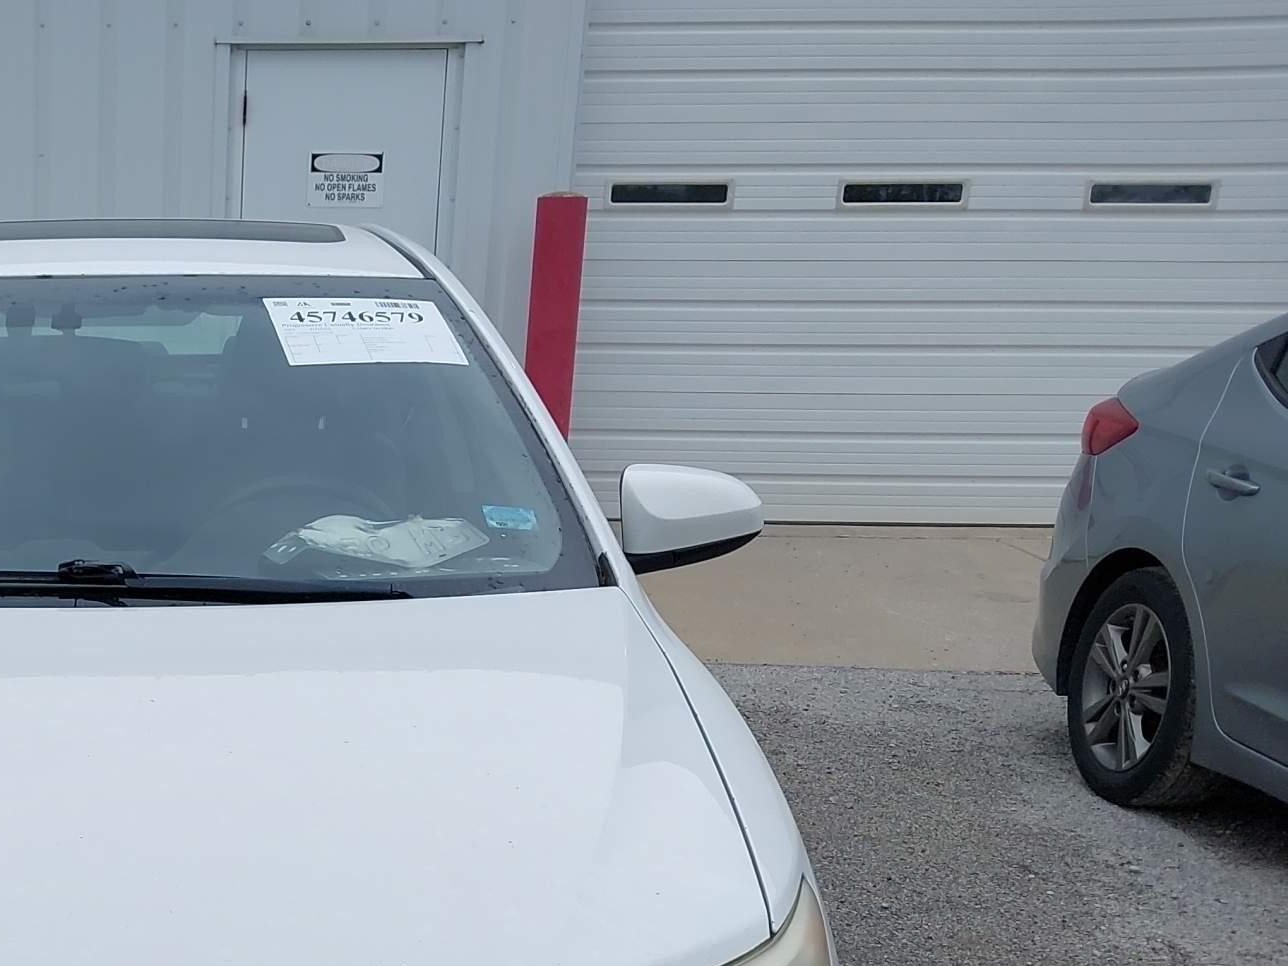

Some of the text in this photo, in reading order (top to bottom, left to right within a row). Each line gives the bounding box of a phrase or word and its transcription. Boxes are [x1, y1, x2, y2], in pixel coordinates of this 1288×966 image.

[324, 174, 368, 182] NO SMOKING
[314, 183, 377, 192] NO OPEN FLAMES
[325, 192, 366, 201] NO SPARKS
[289, 311, 424, 324] 45746579
